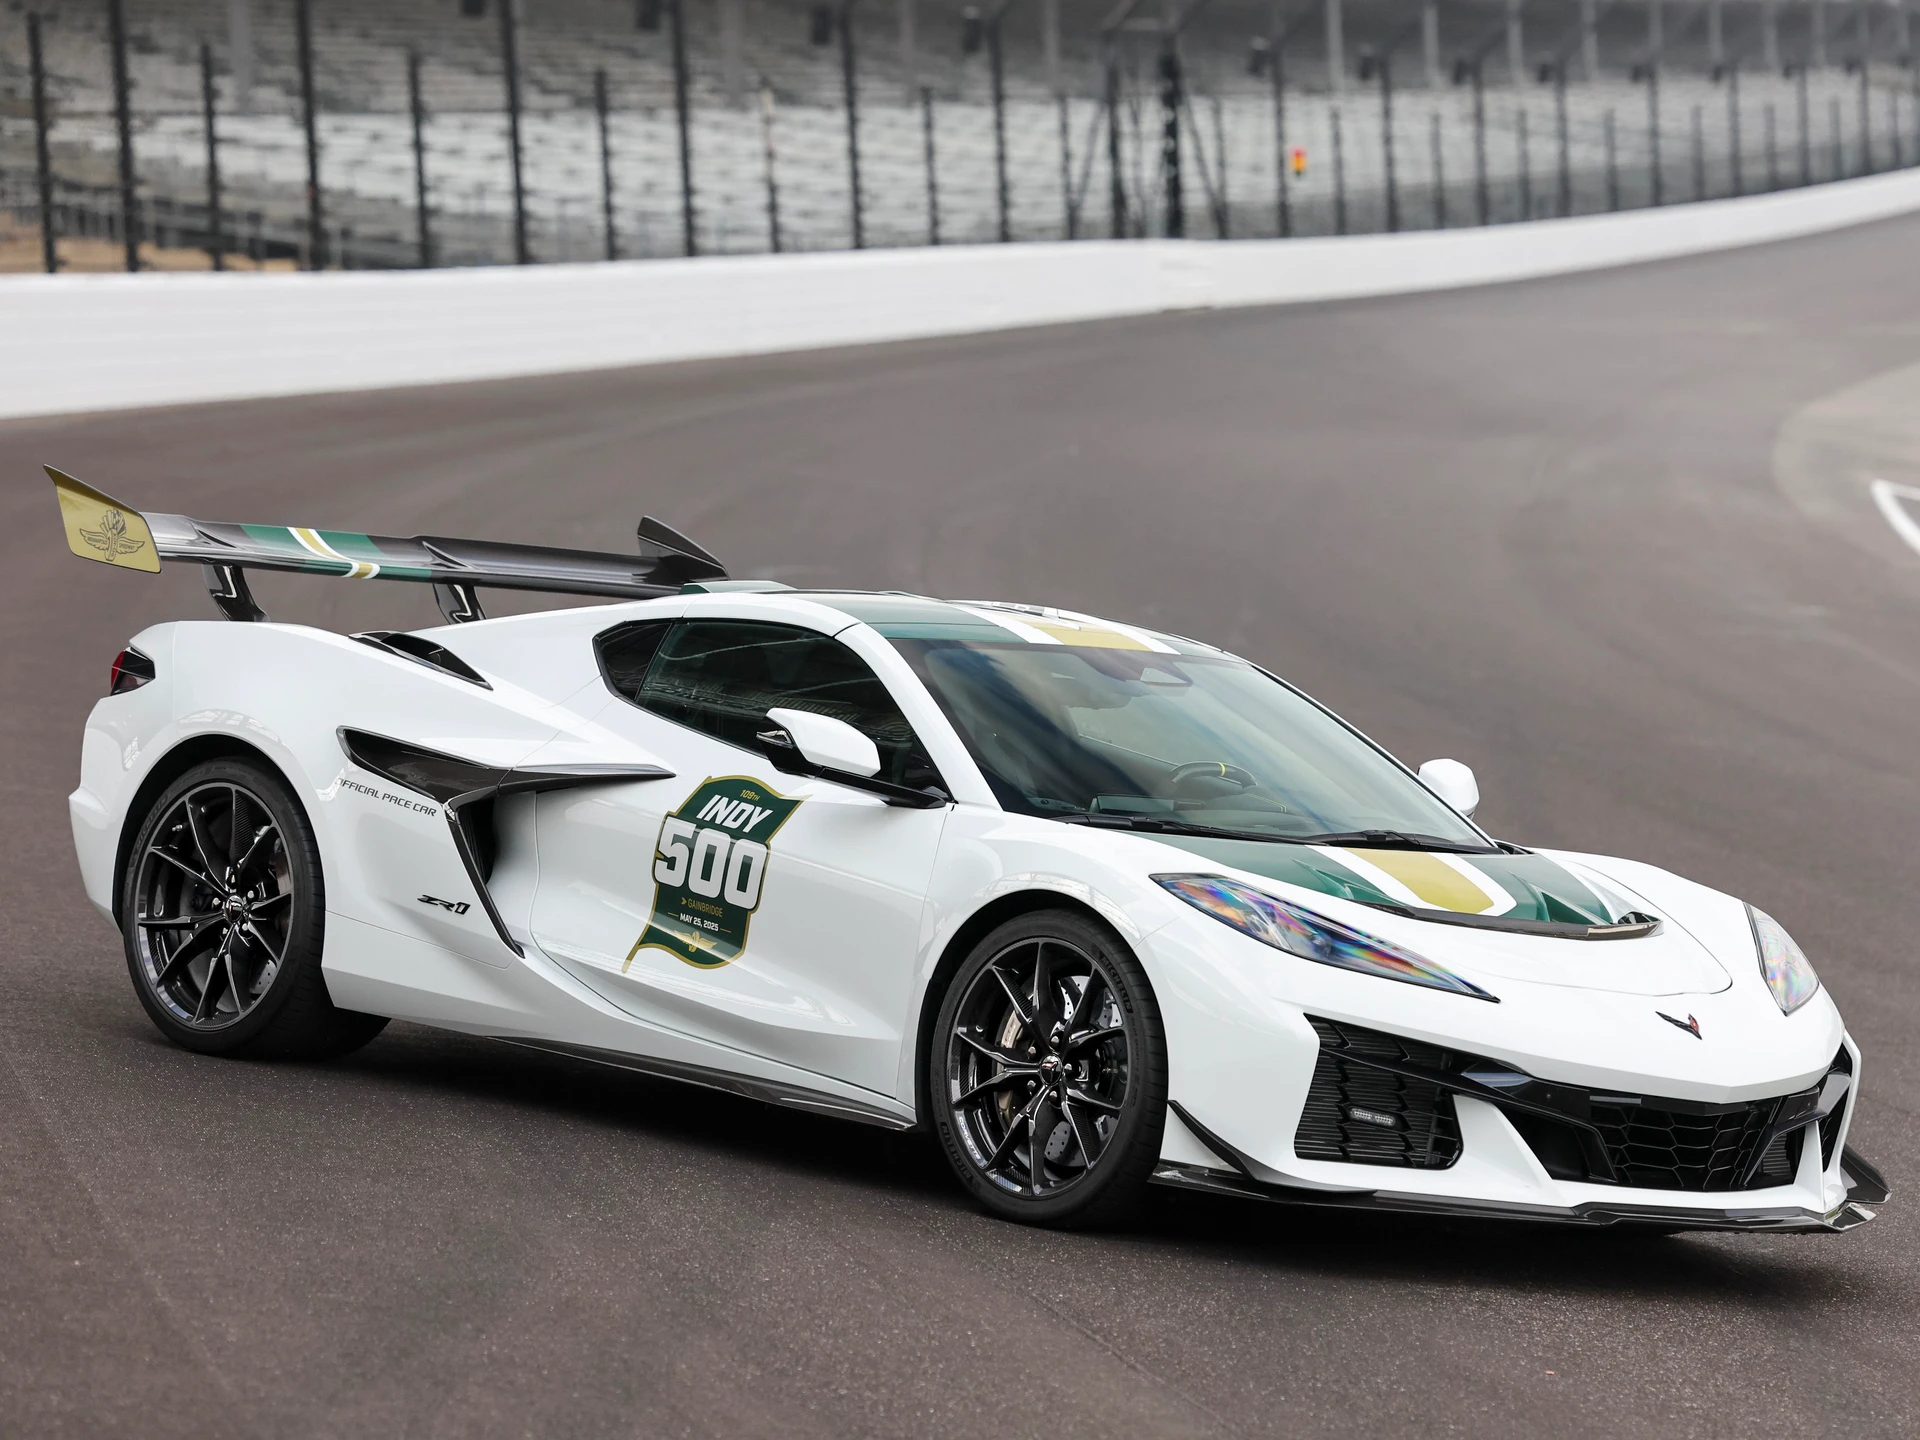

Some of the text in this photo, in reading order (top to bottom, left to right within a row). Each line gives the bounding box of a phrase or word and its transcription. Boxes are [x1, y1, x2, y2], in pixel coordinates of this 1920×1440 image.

[382, 793, 412, 809] PACE
[413, 803, 437, 817] CAR
[740, 789, 760, 801] 109TH
[696, 794, 773, 833] INDY
[654, 817, 767, 910] 500
[417, 894, 471, 915] ZR1
[687, 898, 723, 918] GAINBRIDGE
[679, 912, 719, 932] MAY 25, 2025
[1100, 956, 1134, 1014] MICHELIN
[940, 1122, 973, 1180] MICHELIN
[958, 1116, 982, 1160] CORVETTE
